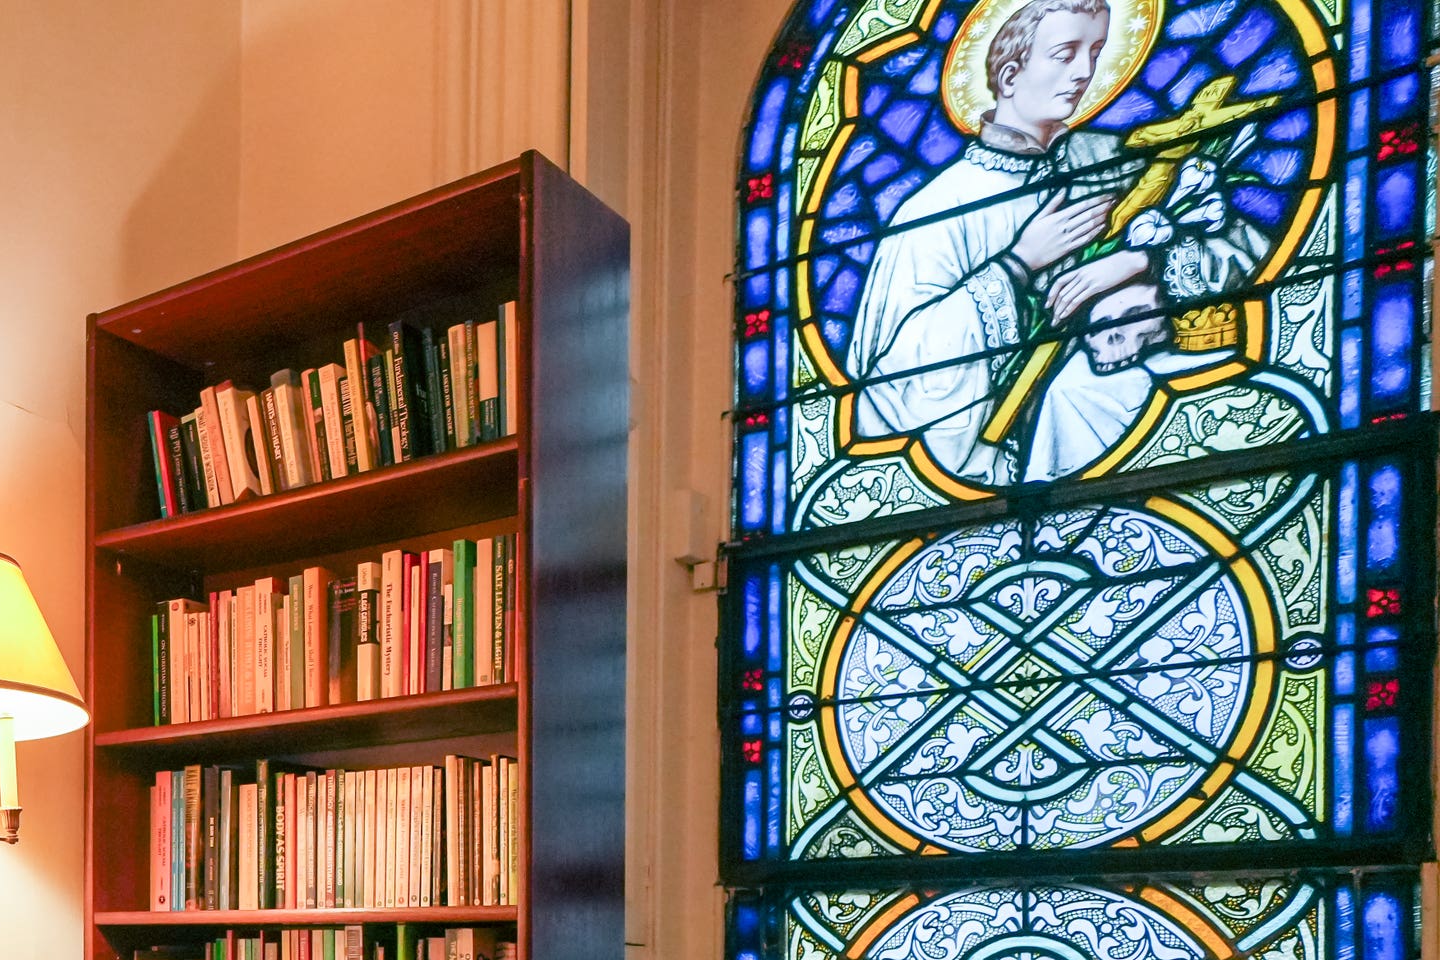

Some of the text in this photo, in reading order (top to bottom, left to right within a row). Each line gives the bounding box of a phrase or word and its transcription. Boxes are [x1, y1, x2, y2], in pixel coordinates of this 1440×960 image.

[394, 356, 410, 449] Fundamental Theology
[384, 646, 392, 677] Mystery
[494, 640, 502, 670] LIGHT
[275, 806, 285, 890] BODY AS SPIRIT
